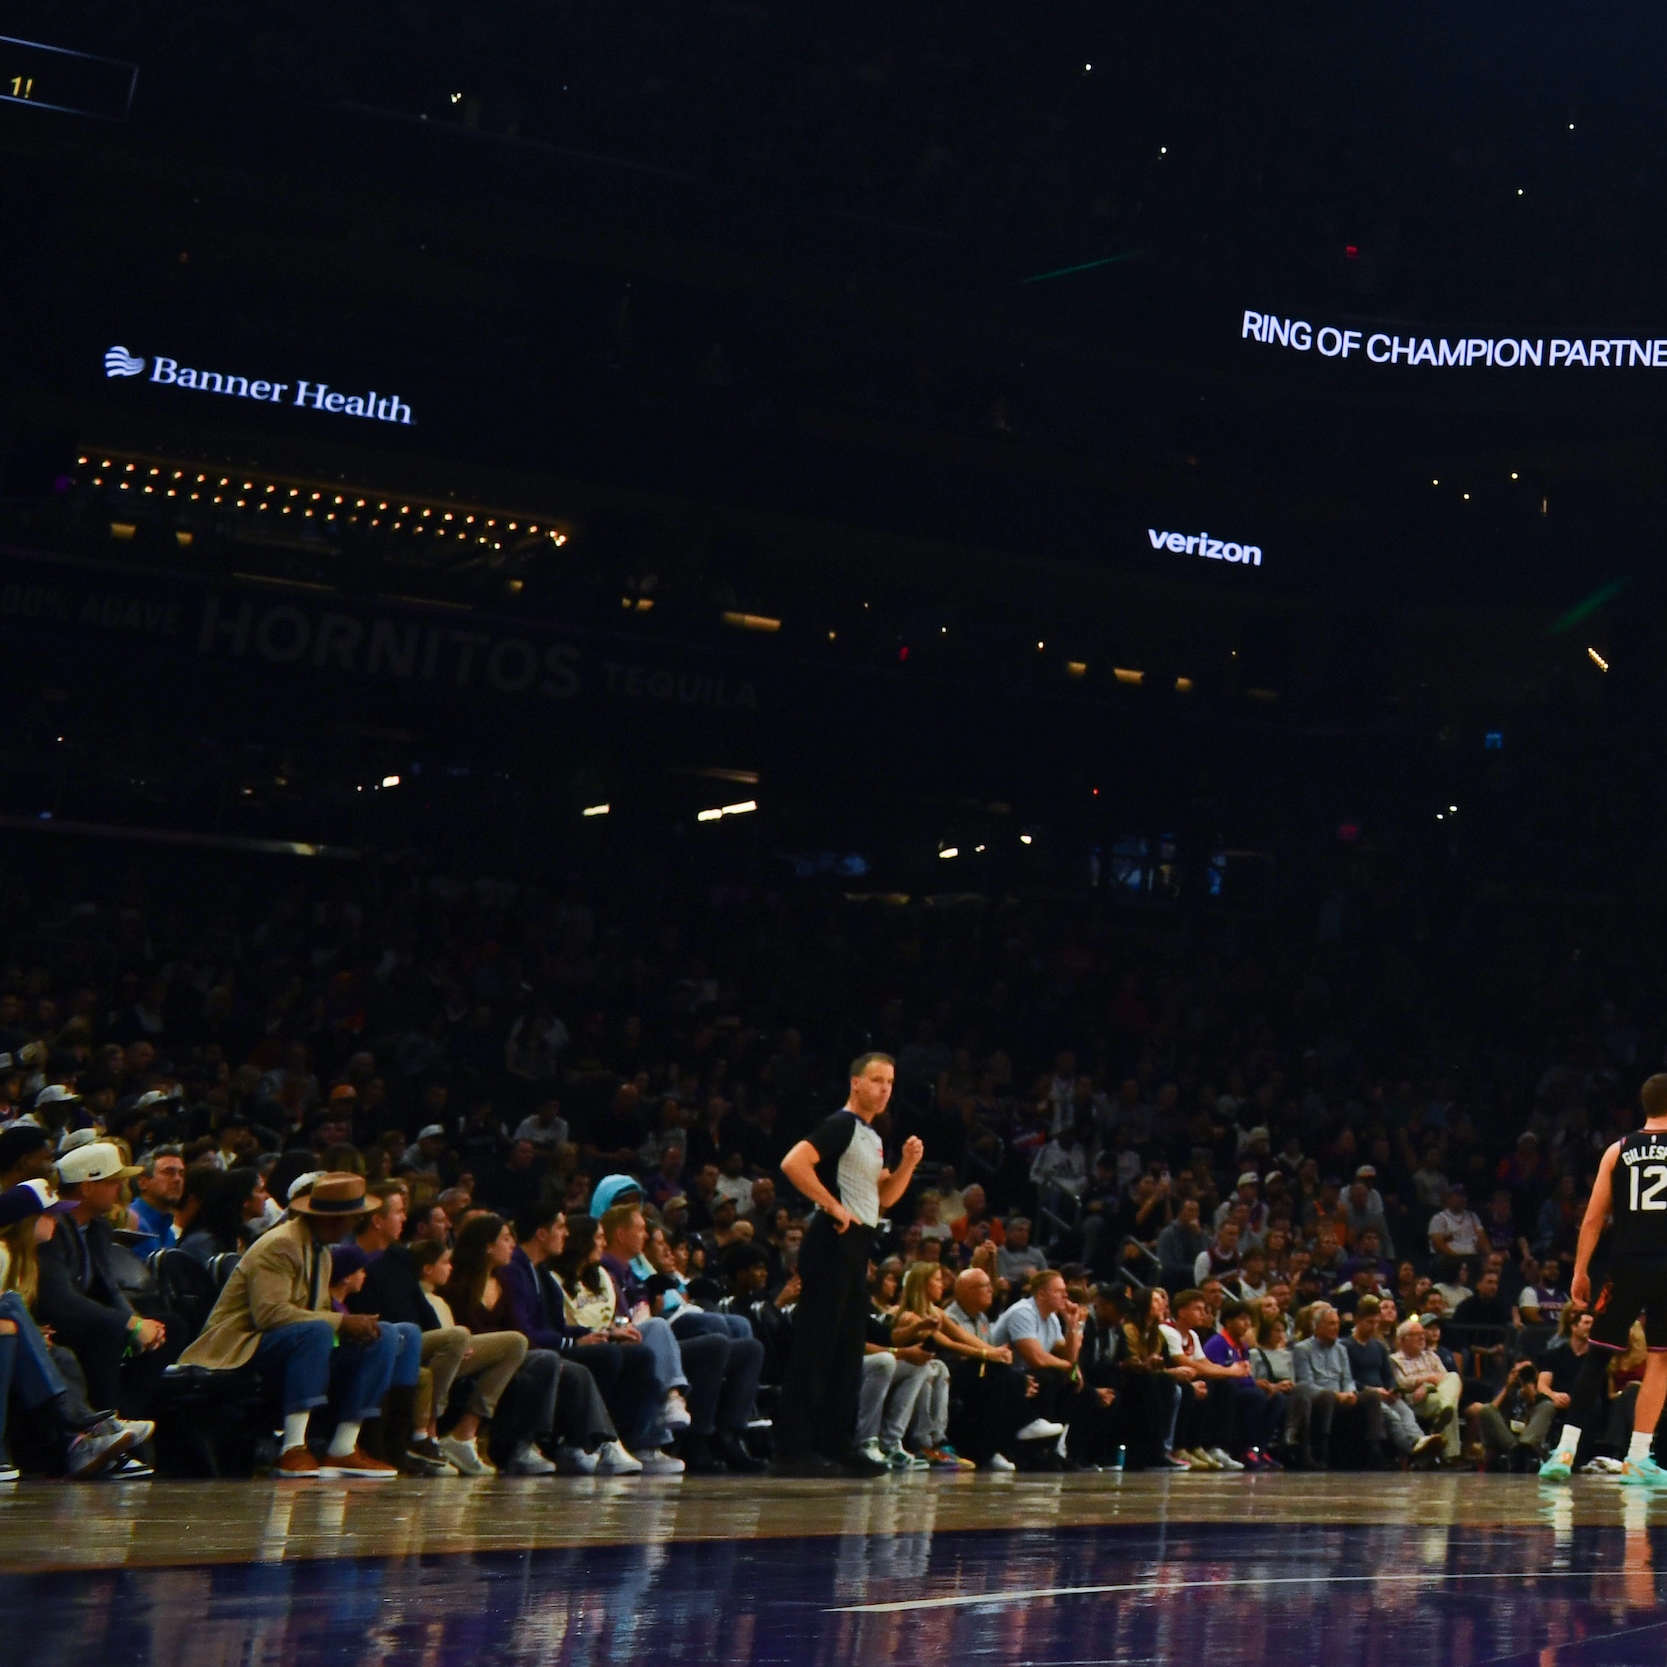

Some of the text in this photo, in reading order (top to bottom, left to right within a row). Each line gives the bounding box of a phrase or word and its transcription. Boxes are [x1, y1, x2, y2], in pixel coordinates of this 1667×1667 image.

[1242, 310, 1312, 350] RING
[1317, 327, 1362, 358] OF
[1367, 334, 1543, 366] CHAMPION
[150, 357, 410, 424] Banner Health
[1149, 529, 1262, 566] verizon
[200, 595, 583, 700] HORNITOS
[600, 661, 759, 711] TEQUILA
